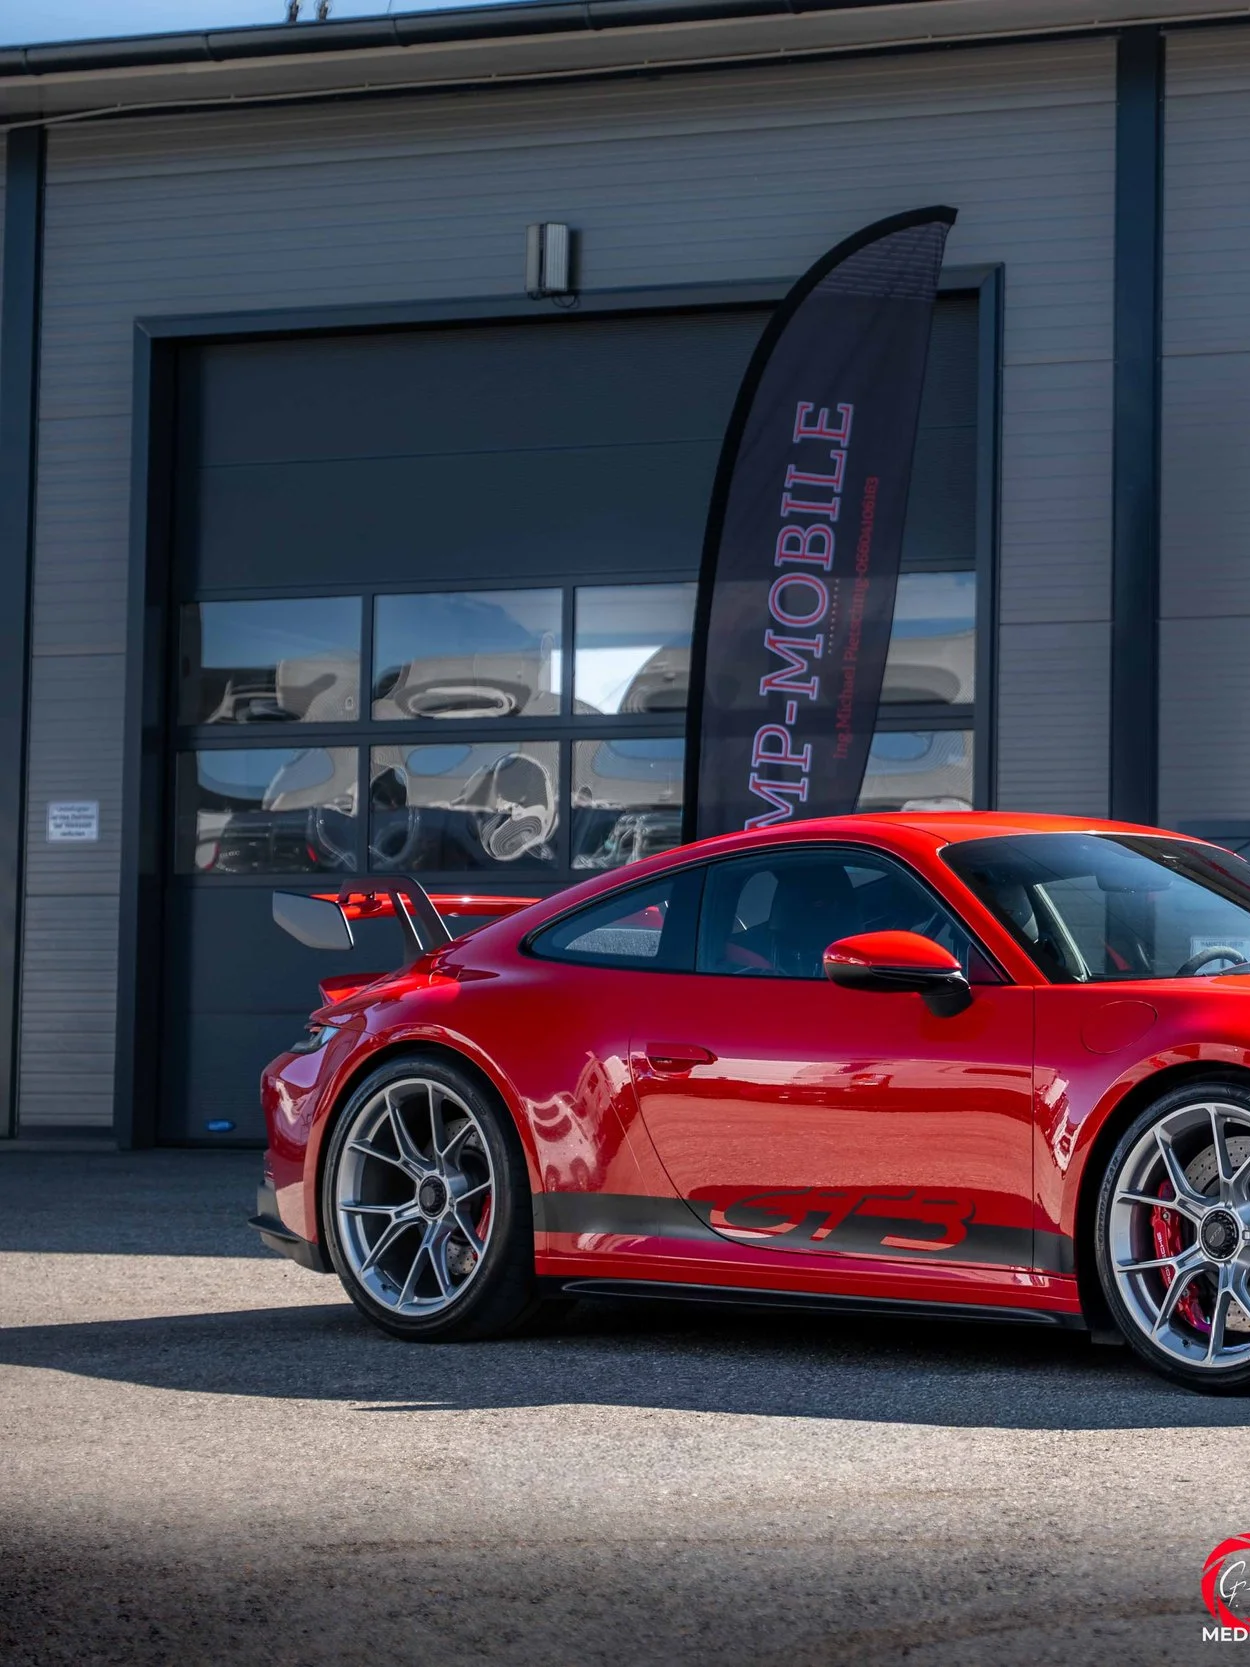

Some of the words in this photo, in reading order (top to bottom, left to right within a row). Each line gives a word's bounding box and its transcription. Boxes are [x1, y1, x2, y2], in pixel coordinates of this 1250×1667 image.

[745, 401, 854, 829] MP-MOBILE
[709, 1186, 976, 1251] GT3
[1156, 1231, 1172, 1286] POCHE
